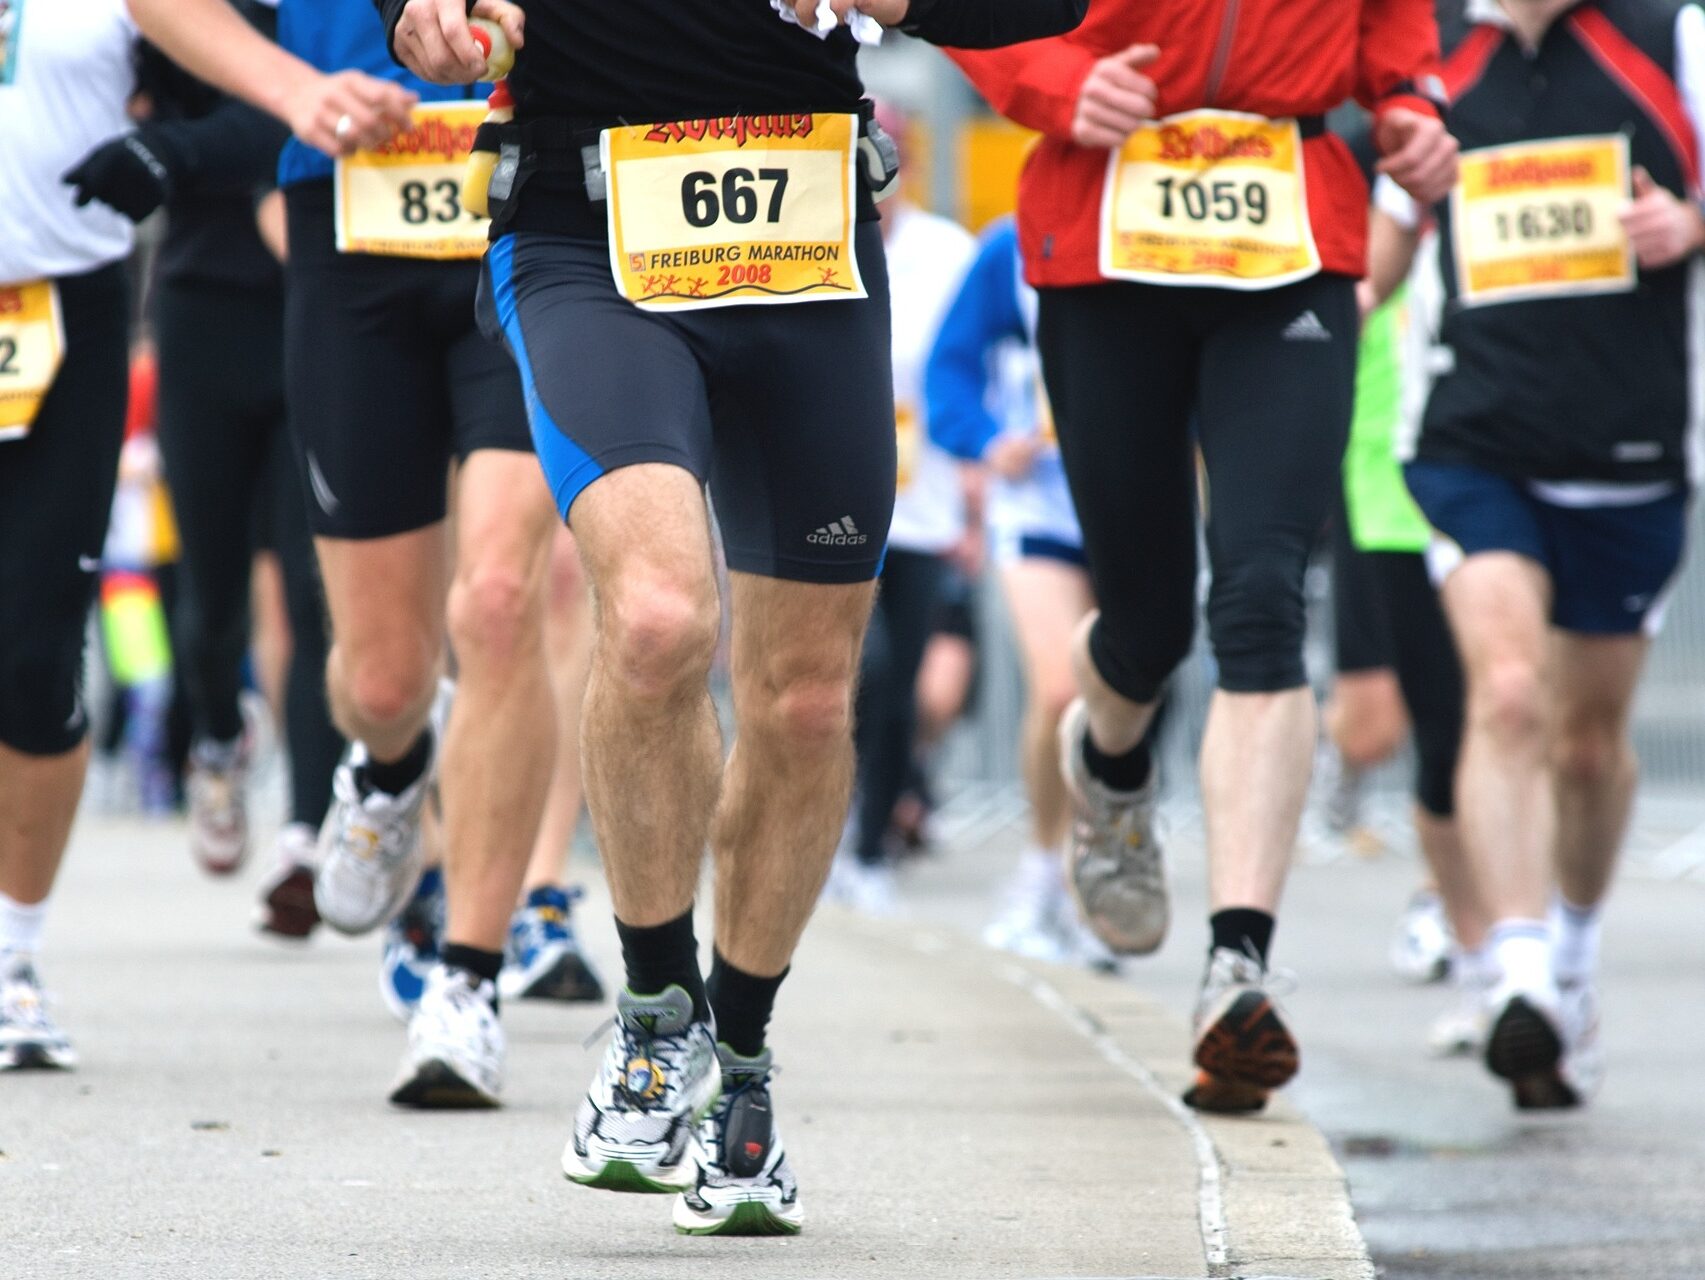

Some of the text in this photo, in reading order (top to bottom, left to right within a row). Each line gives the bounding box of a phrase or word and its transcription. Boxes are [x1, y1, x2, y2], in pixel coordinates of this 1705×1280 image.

[401, 179, 484, 224] 83
[680, 167, 790, 229] 667
[1155, 176, 1268, 226] 1059
[1495, 201, 1595, 242] 1630
[650, 245, 741, 270] FREIBURG
[747, 245, 839, 262] MARATHON
[716, 263, 773, 287] 2008
[806, 533, 867, 546] adidas
